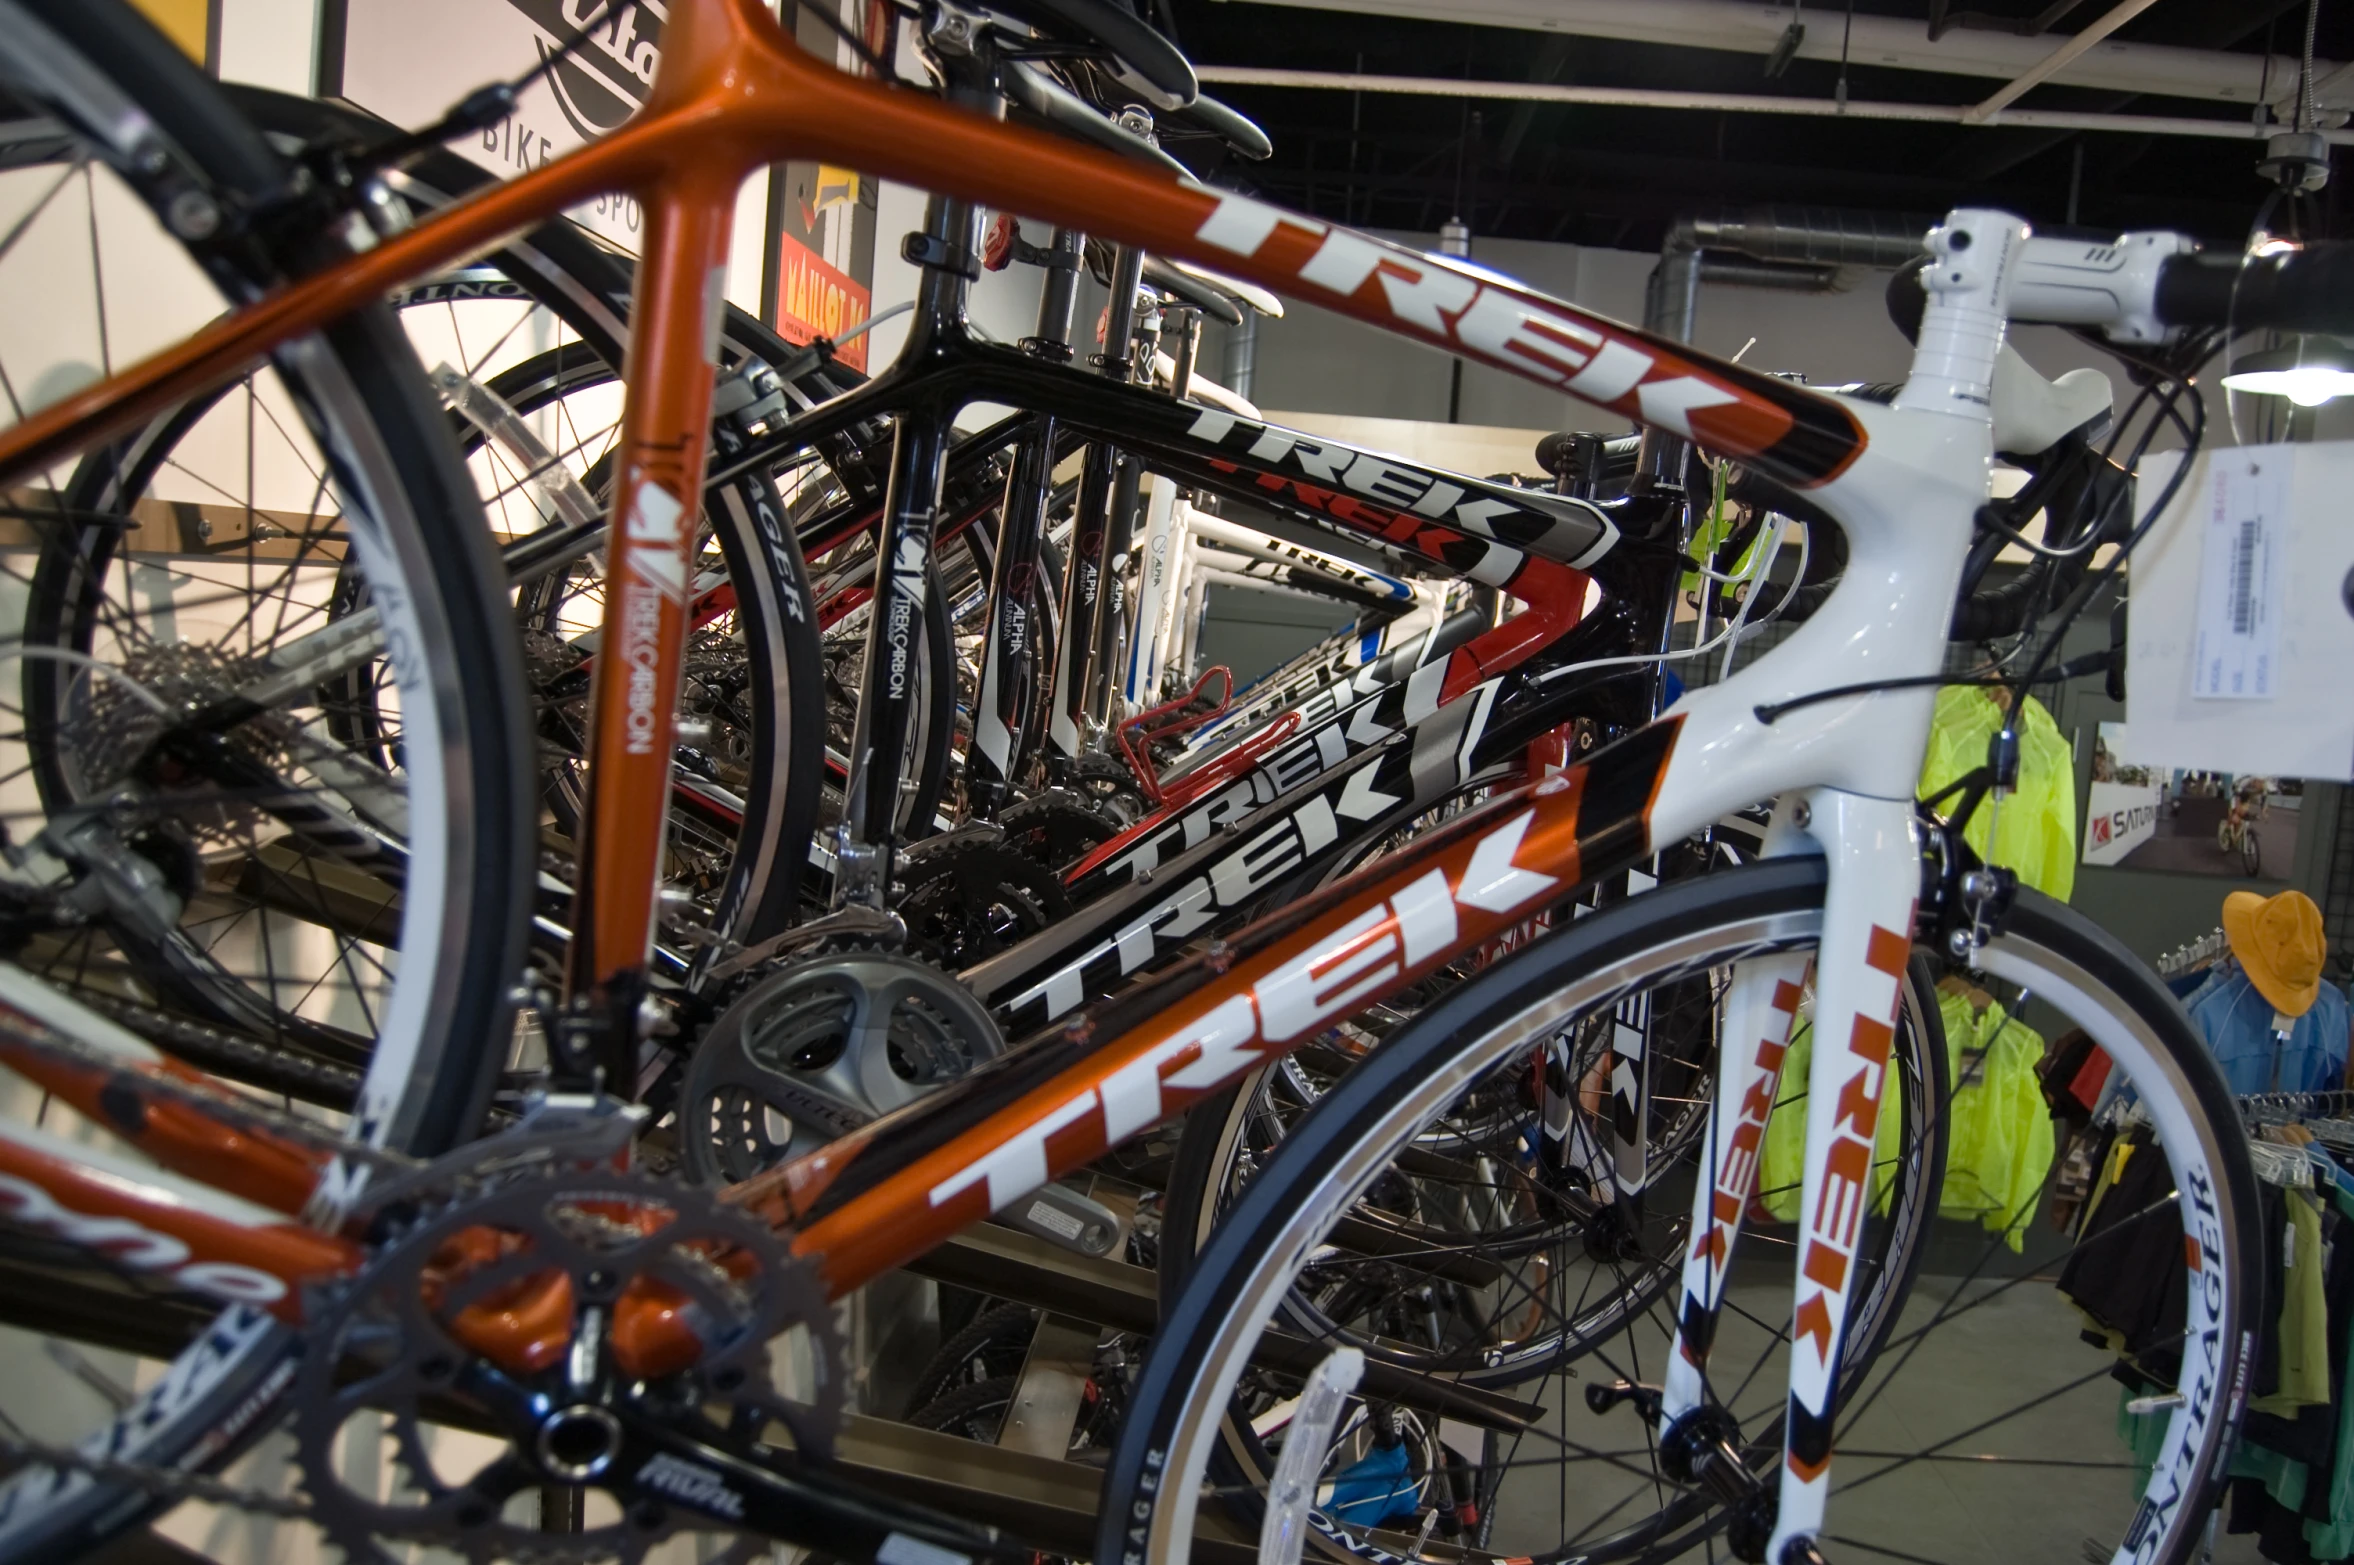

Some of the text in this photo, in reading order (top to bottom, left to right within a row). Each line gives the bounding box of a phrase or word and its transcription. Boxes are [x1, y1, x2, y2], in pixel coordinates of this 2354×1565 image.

[596, 190, 641, 233] SPO
[1178, 175, 1742, 442] TREK
[1177, 399, 1523, 538] TREK
[1085, 563, 1097, 606] ALPHA
[1113, 580, 1124, 614] ALPHA
[1153, 557, 1163, 588] ALPHA
[1264, 536, 1374, 587] TREK
[1003, 596, 1013, 641] ALUMINUM
[1009, 603, 1026, 656] ALPHA
[1106, 694, 1395, 882] TREK
[1008, 754, 1400, 1022] TREK
[929, 808, 1559, 1213] TREK
[1693, 958, 1813, 1275] TREK
[1795, 898, 1919, 1370] TREK
